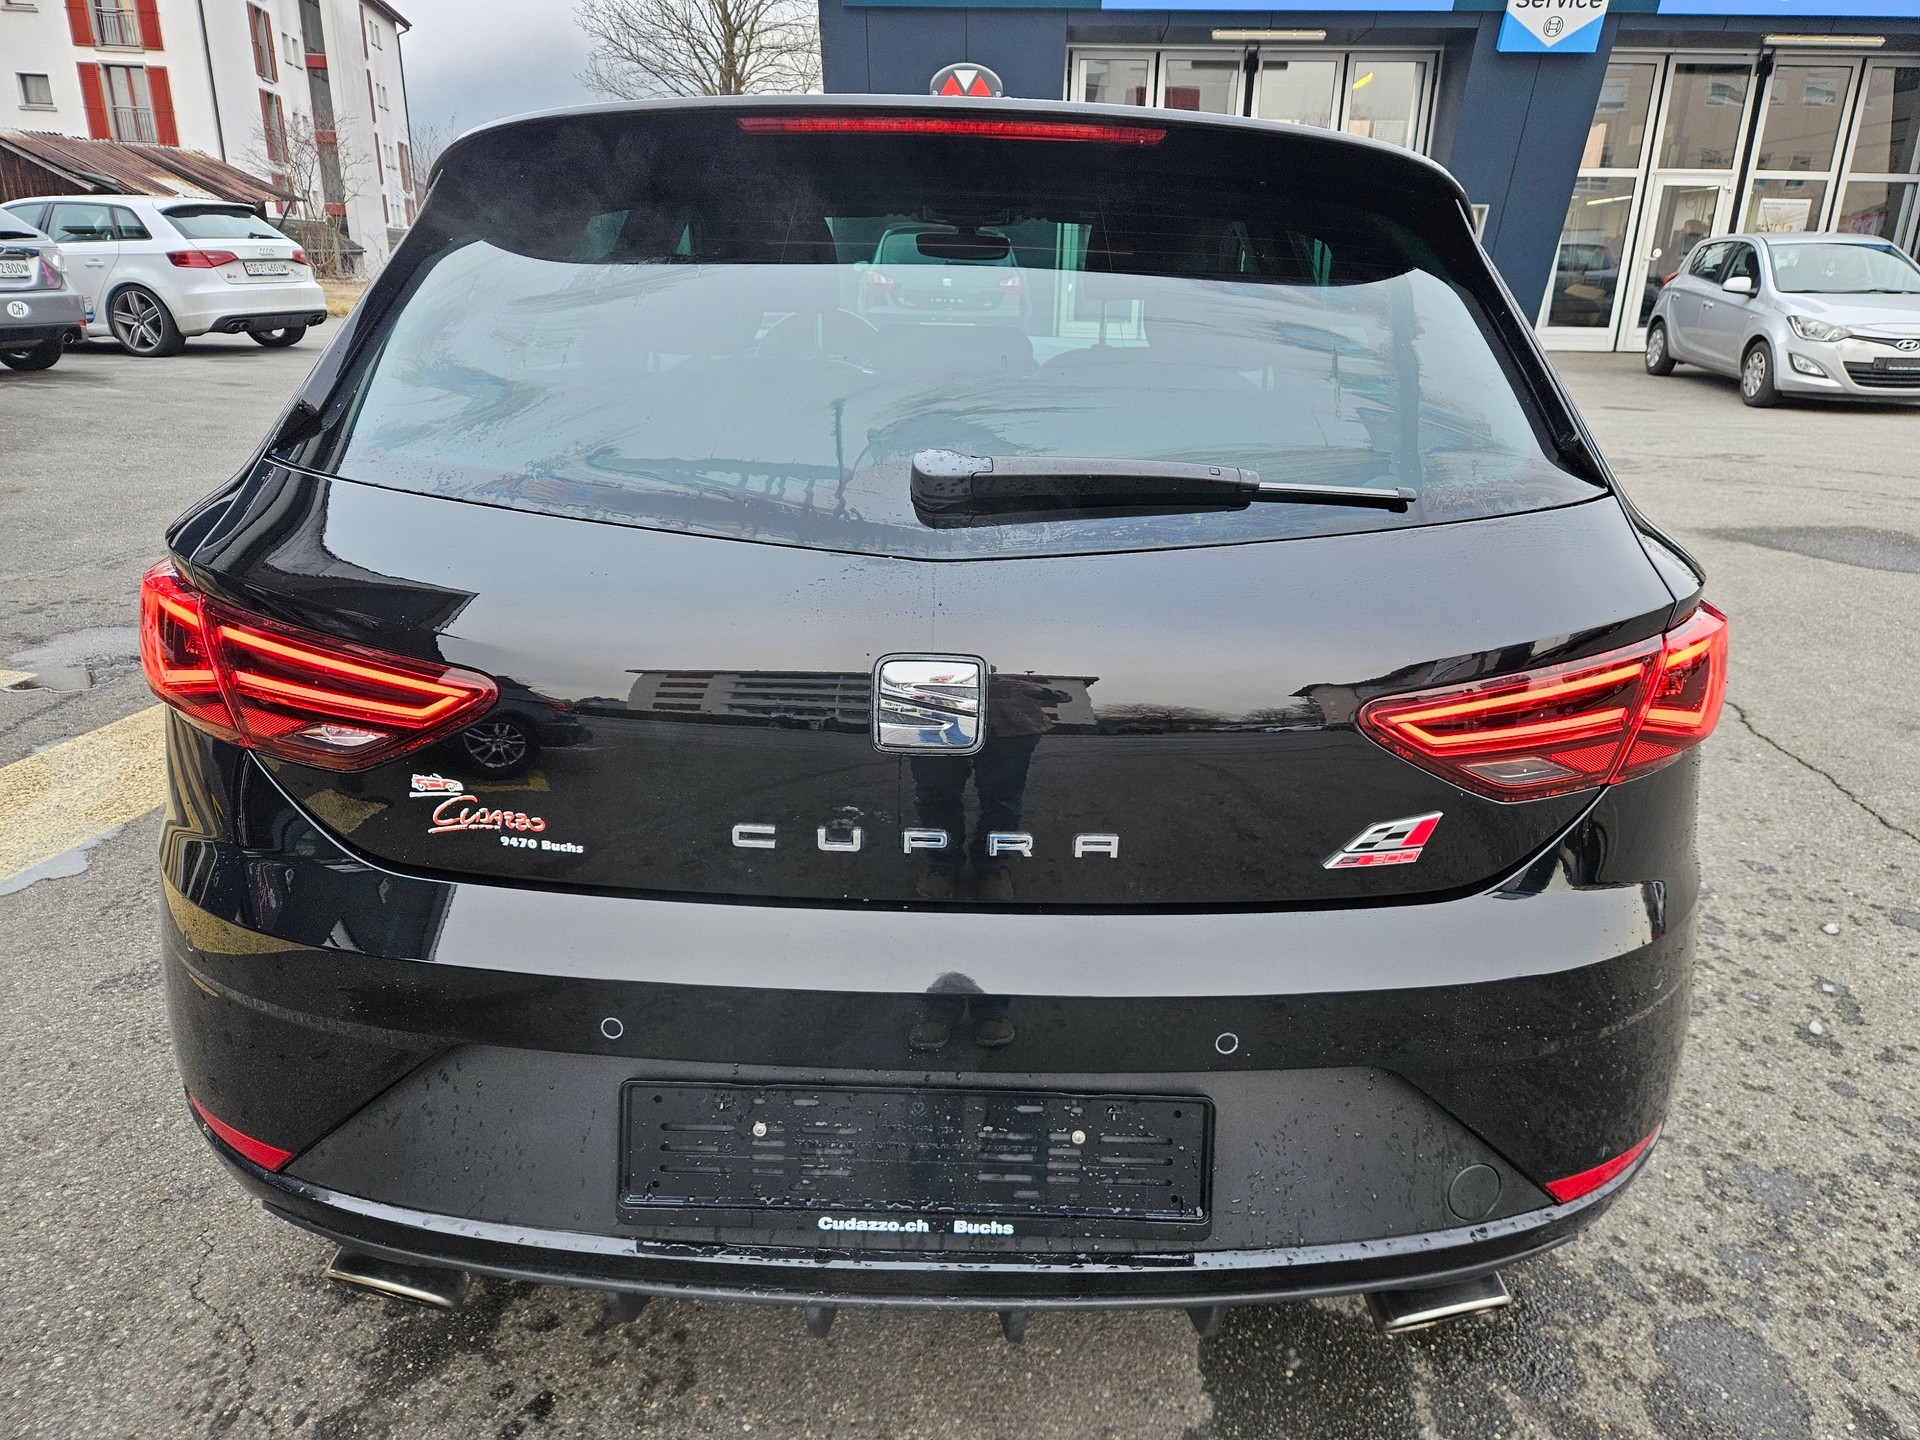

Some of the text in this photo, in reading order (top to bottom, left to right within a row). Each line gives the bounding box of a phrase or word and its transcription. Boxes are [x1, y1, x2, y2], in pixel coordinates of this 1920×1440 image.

[11, 303, 25, 316] CH
[500, 836, 584, 854] 9470 Buchs
[731, 823, 1120, 859] CUPRA
[1370, 852, 1415, 864] 300
[817, 1216, 1015, 1235] Cudazzo.ch Buchs
